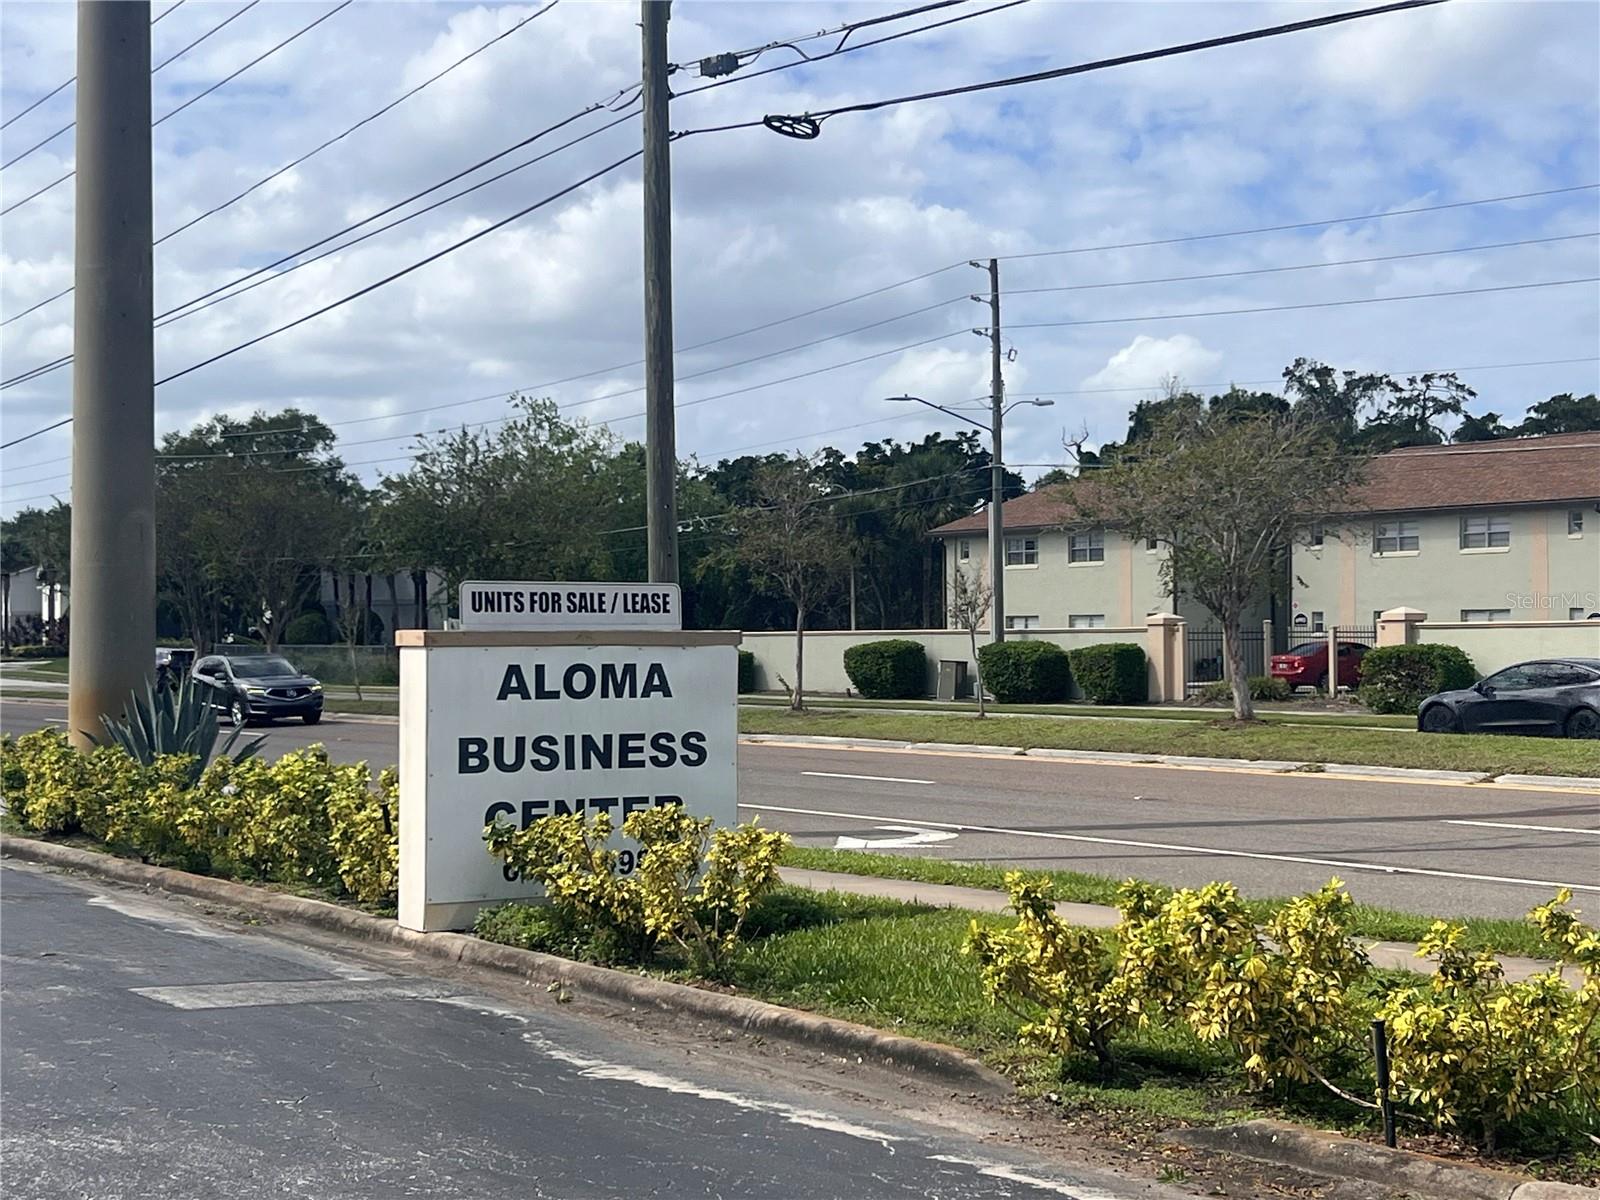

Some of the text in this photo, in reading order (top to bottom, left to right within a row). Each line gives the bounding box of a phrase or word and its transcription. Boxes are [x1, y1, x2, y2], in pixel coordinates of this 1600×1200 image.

[472, 591, 671, 614] UNITS FOR SALE / LEASE
[497, 663, 672, 700] ALOMA
[458, 731, 708, 774] BUSINESS
[484, 795, 684, 832] CENTE
